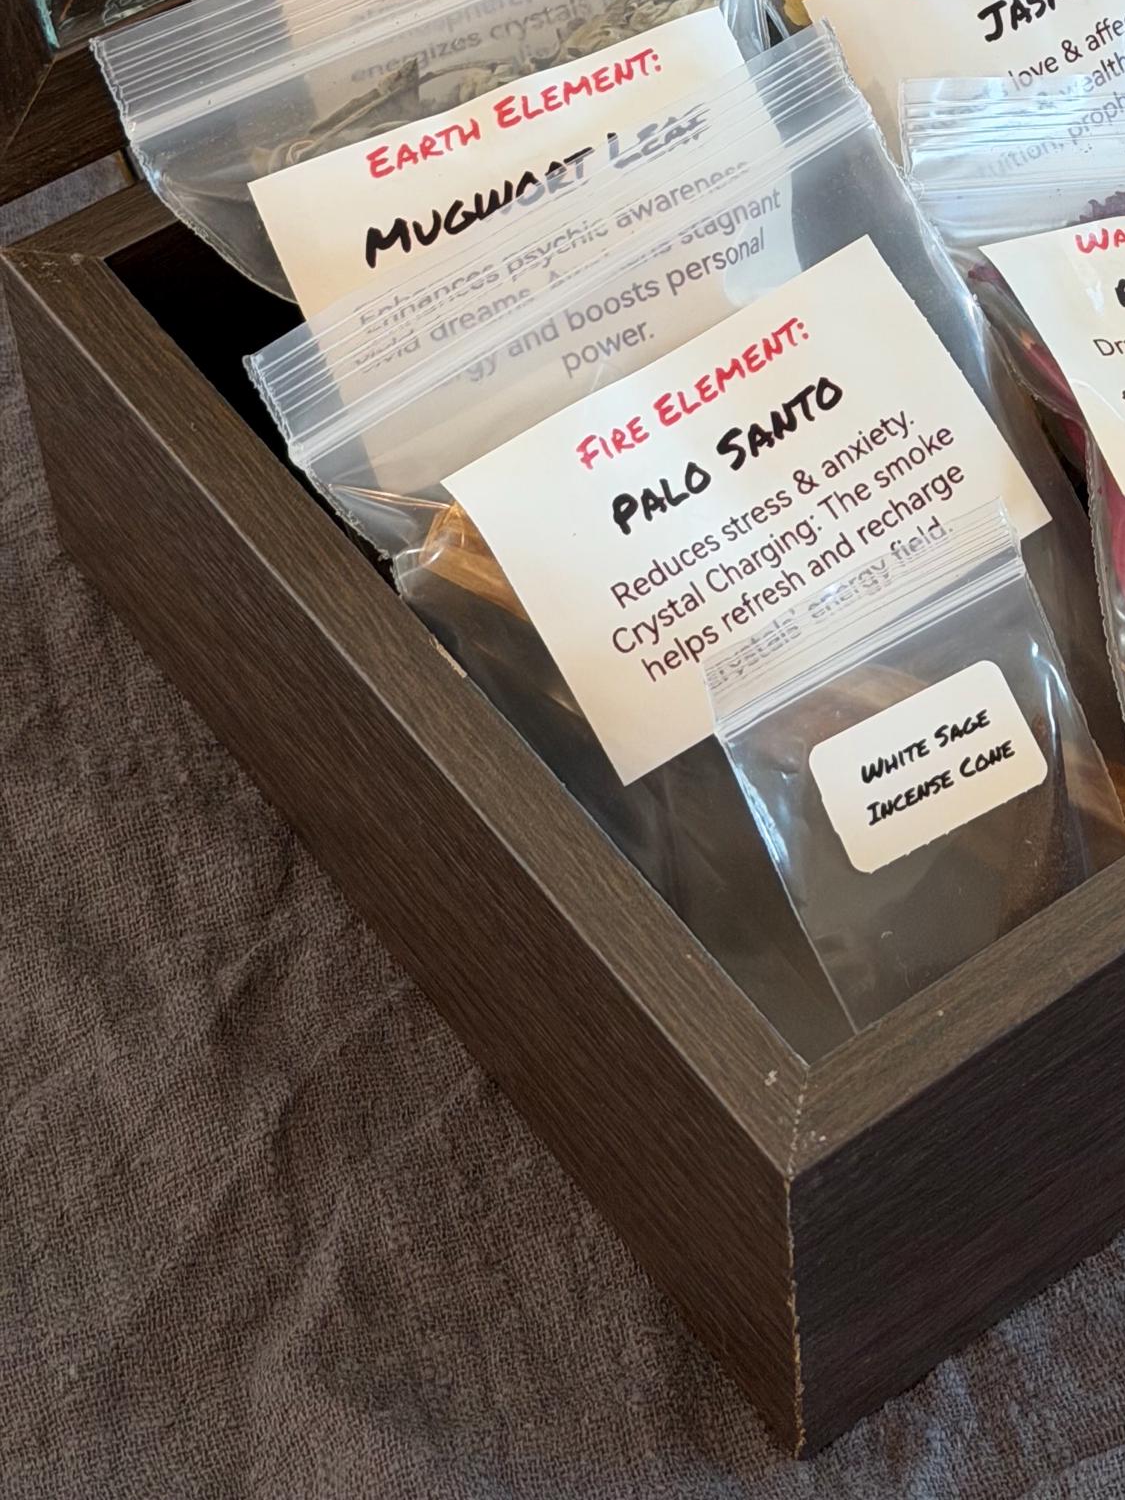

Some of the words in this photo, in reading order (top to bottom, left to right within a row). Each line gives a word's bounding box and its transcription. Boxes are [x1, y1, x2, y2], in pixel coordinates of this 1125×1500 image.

[366, 118, 480, 180] EARTH
[493, 47, 663, 129] ELEMENT:
[1009, 52, 1059, 92] love
[1061, 39, 1084, 62] &
[363, 145, 596, 269] MUGWORT
[508, 319, 561, 358] and
[564, 276, 661, 333] boosts
[666, 225, 766, 297] personal
[561, 321, 656, 380] power.
[576, 415, 650, 471] FIRE
[653, 316, 810, 427] ELEMENT:
[611, 461, 712, 536] PALO
[716, 376, 844, 471] SANTO
[609, 536, 721, 610] Reduces
[721, 492, 793, 542] stress
[792, 469, 820, 497] &
[819, 410, 915, 480] anxiety.
[611, 581, 707, 655] Crystal
[705, 512, 824, 593] Charging:
[817, 482, 872, 522] The
[873, 424, 955, 488] smoke
[640, 628, 720, 683] helps
[720, 566, 807, 634] refresh
[806, 538, 856, 579] and
[855, 463, 966, 548] recharge
[860, 738, 931, 784] WHITE
[933, 708, 991, 748] SAGE
[866, 770, 955, 827] INCENSE
[959, 740, 1016, 778] CONE
